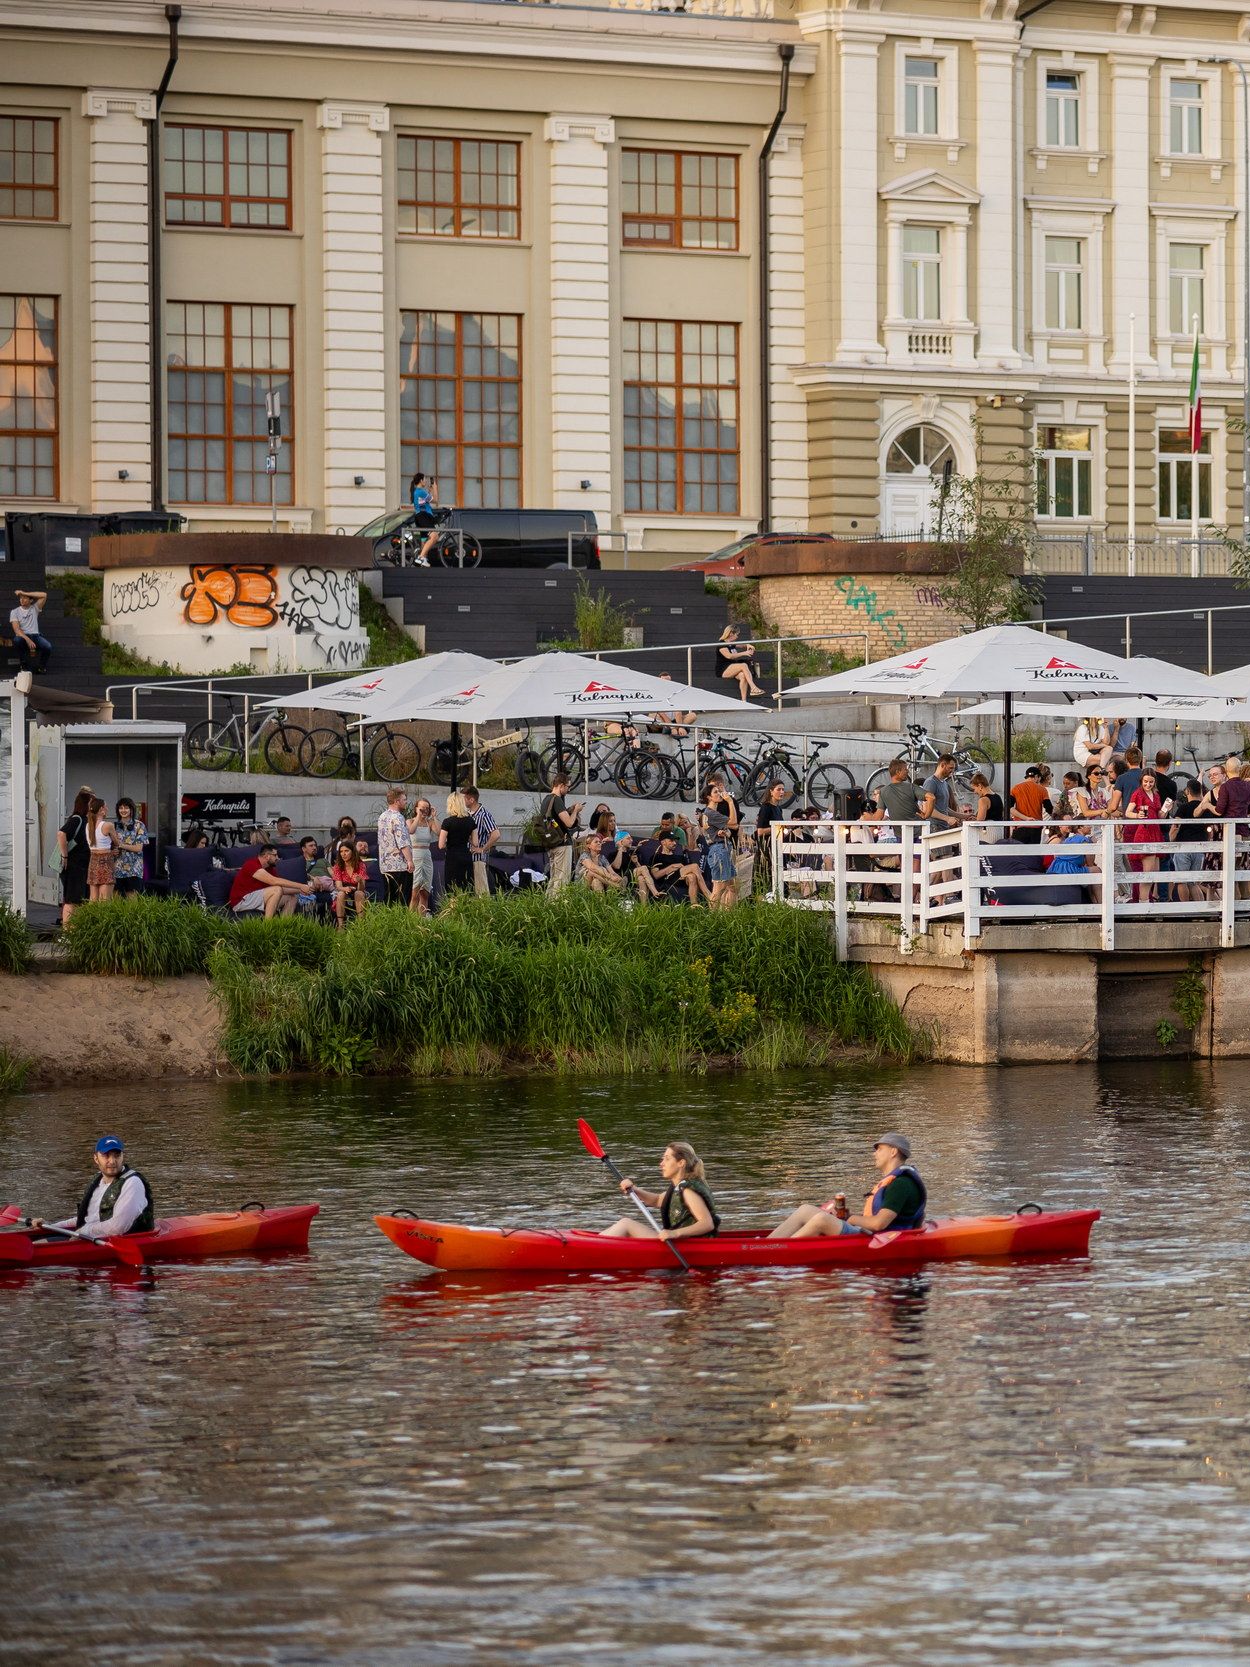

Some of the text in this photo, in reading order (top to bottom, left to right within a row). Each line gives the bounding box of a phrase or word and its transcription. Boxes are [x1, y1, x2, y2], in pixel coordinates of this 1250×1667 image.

[1032, 669, 1120, 680] Kalnapilis
[570, 692, 654, 703] Kalnapilis
[496, 736, 513, 746] MATE
[203, 799, 250, 813] Kalnapilis
[406, 1230, 444, 1243] VISTA
